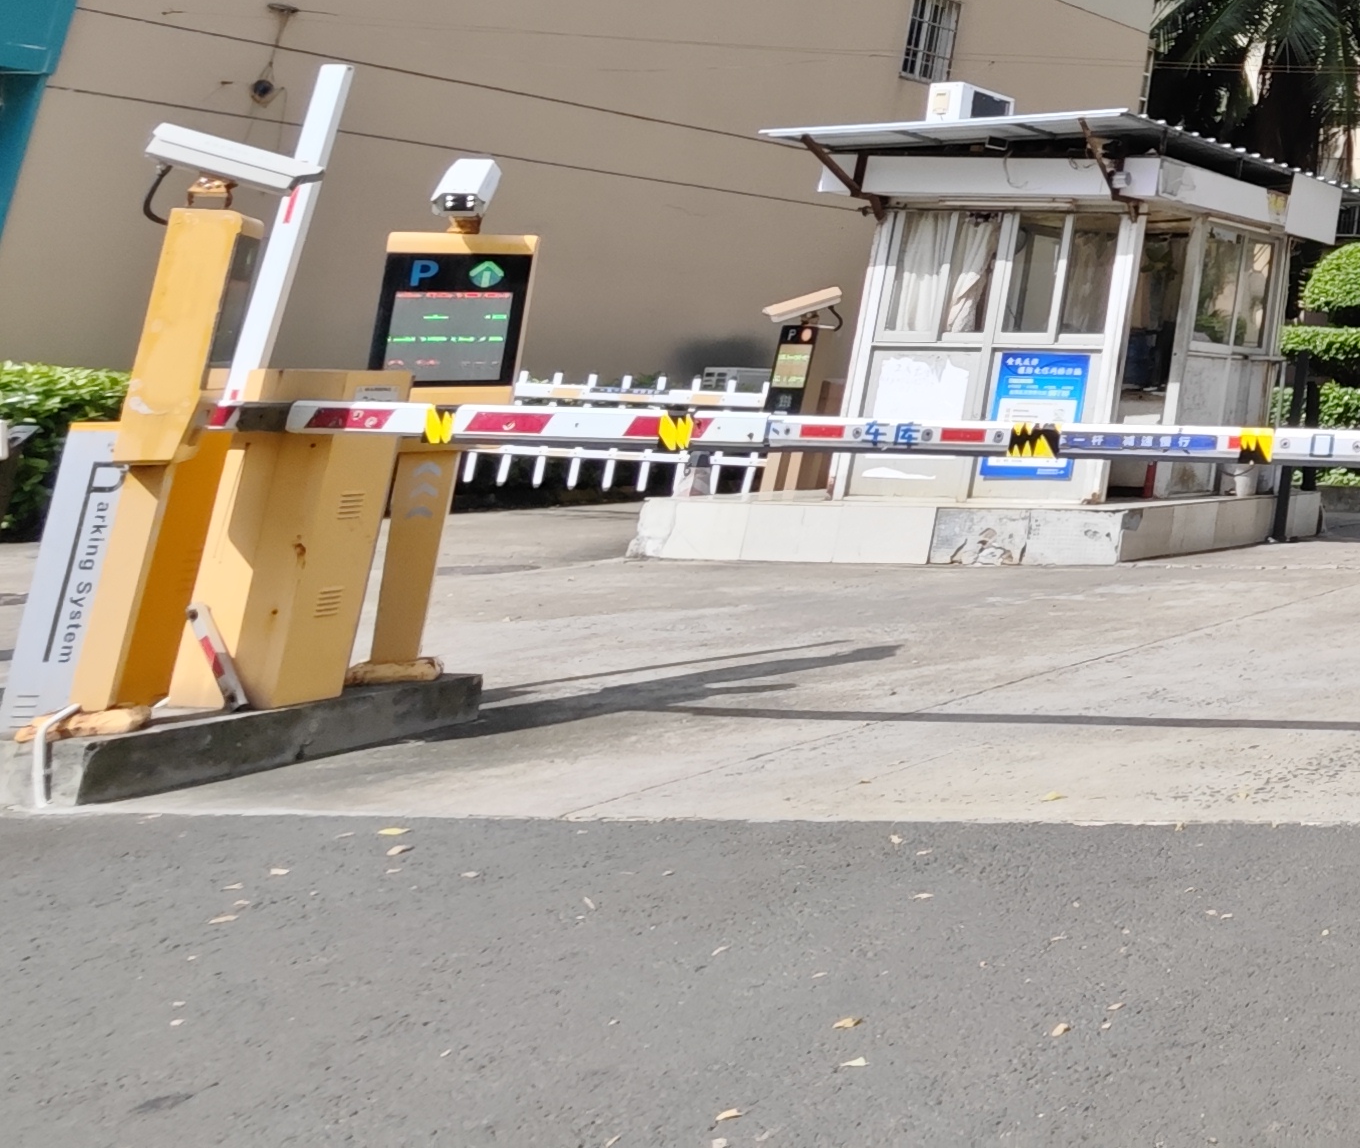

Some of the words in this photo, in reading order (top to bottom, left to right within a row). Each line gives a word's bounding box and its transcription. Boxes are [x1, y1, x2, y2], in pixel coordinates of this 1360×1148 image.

[409, 259, 439, 287] P
[787, 329, 797, 340] P
[863, 420, 921, 450] 车库
[57, 581, 93, 663] System
